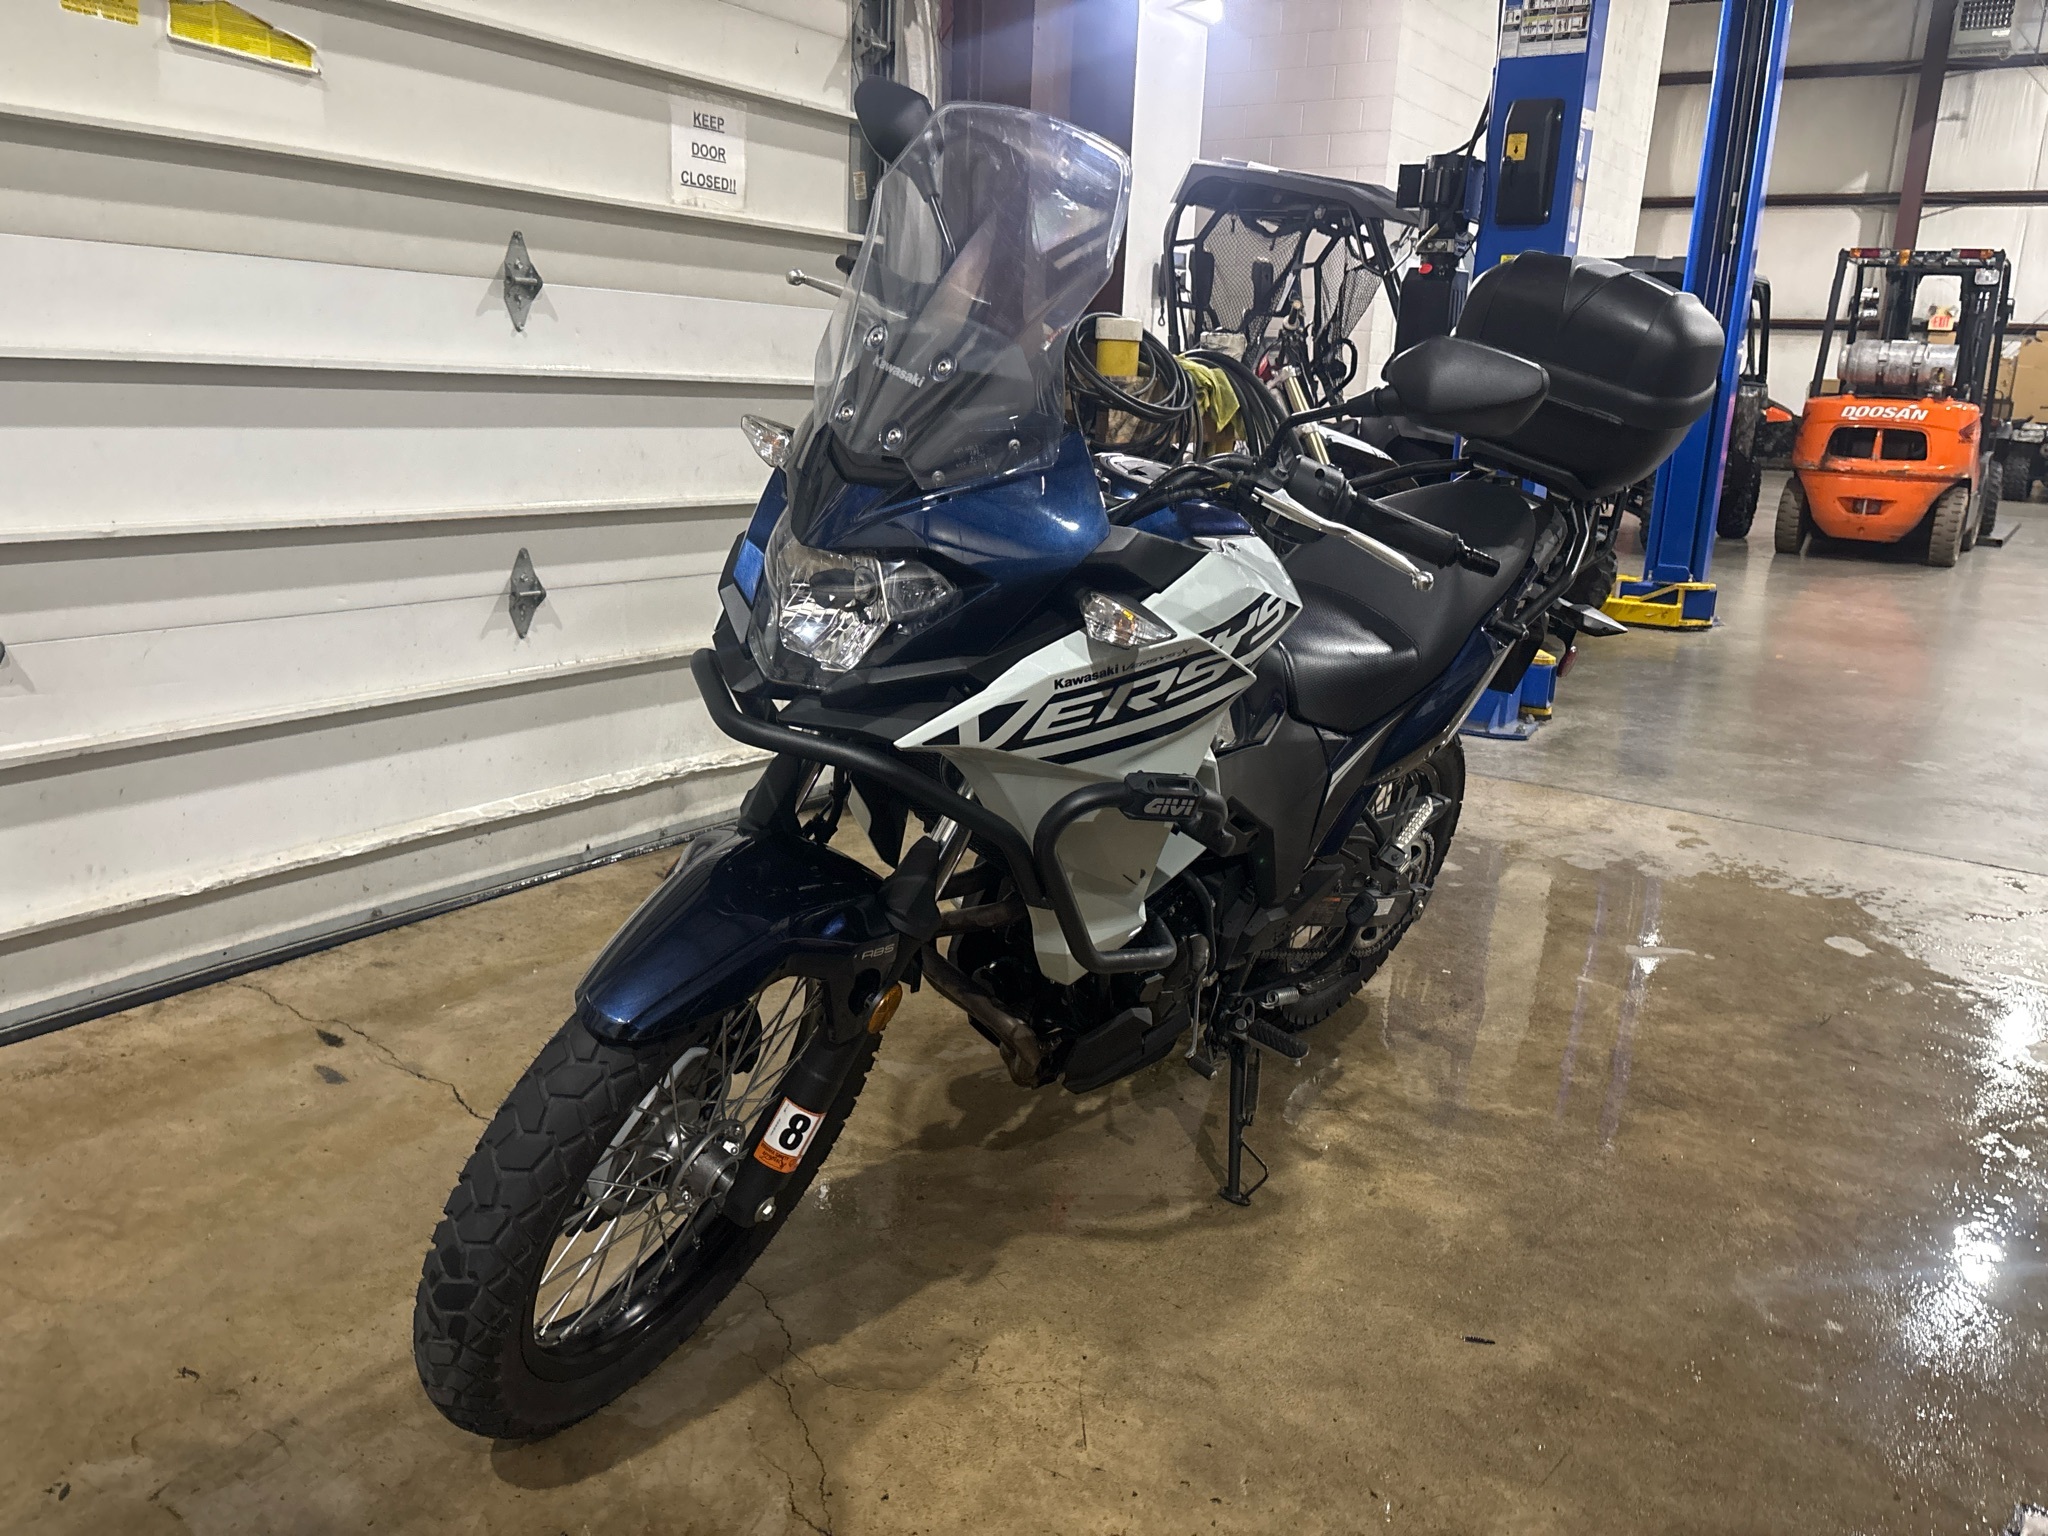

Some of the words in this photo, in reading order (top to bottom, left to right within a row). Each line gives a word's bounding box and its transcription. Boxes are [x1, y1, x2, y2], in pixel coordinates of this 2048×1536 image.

[693, 110, 725, 132] KEEP
[691, 142, 727, 162] DOOR
[681, 170, 737, 193] CLOSED!!
[872, 354, 926, 388] Kawasaki
[1841, 405, 1929, 421] DOOSAN
[1054, 664, 1120, 690] Kawasaki
[1143, 797, 1196, 816] GIVI
[861, 943, 895, 960] ABS
[778, 1113, 812, 1151] 8
